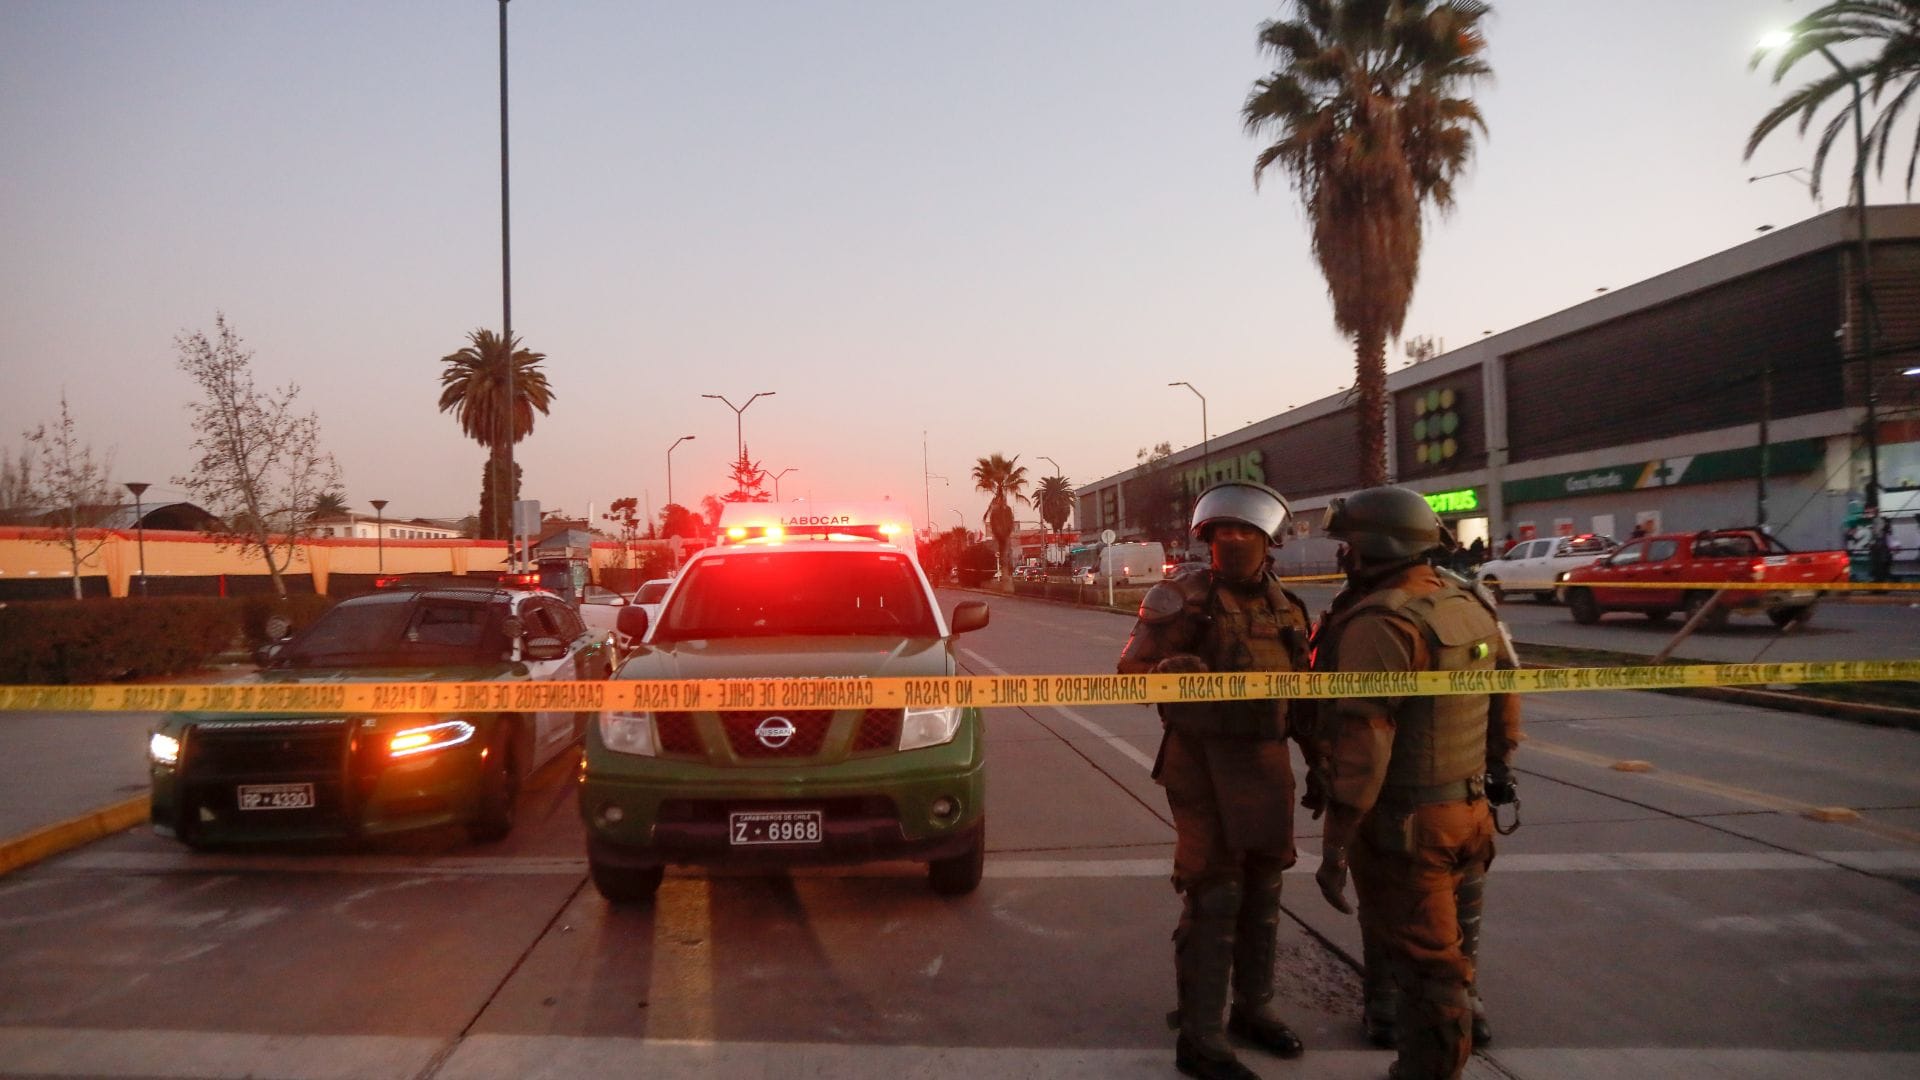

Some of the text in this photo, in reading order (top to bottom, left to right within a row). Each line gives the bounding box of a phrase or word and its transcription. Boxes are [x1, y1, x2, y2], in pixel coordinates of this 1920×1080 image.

[781, 516, 850, 525] LABOCAR
[757, 727, 793, 737] NISSAN
[735, 822, 818, 842] Z 6968
